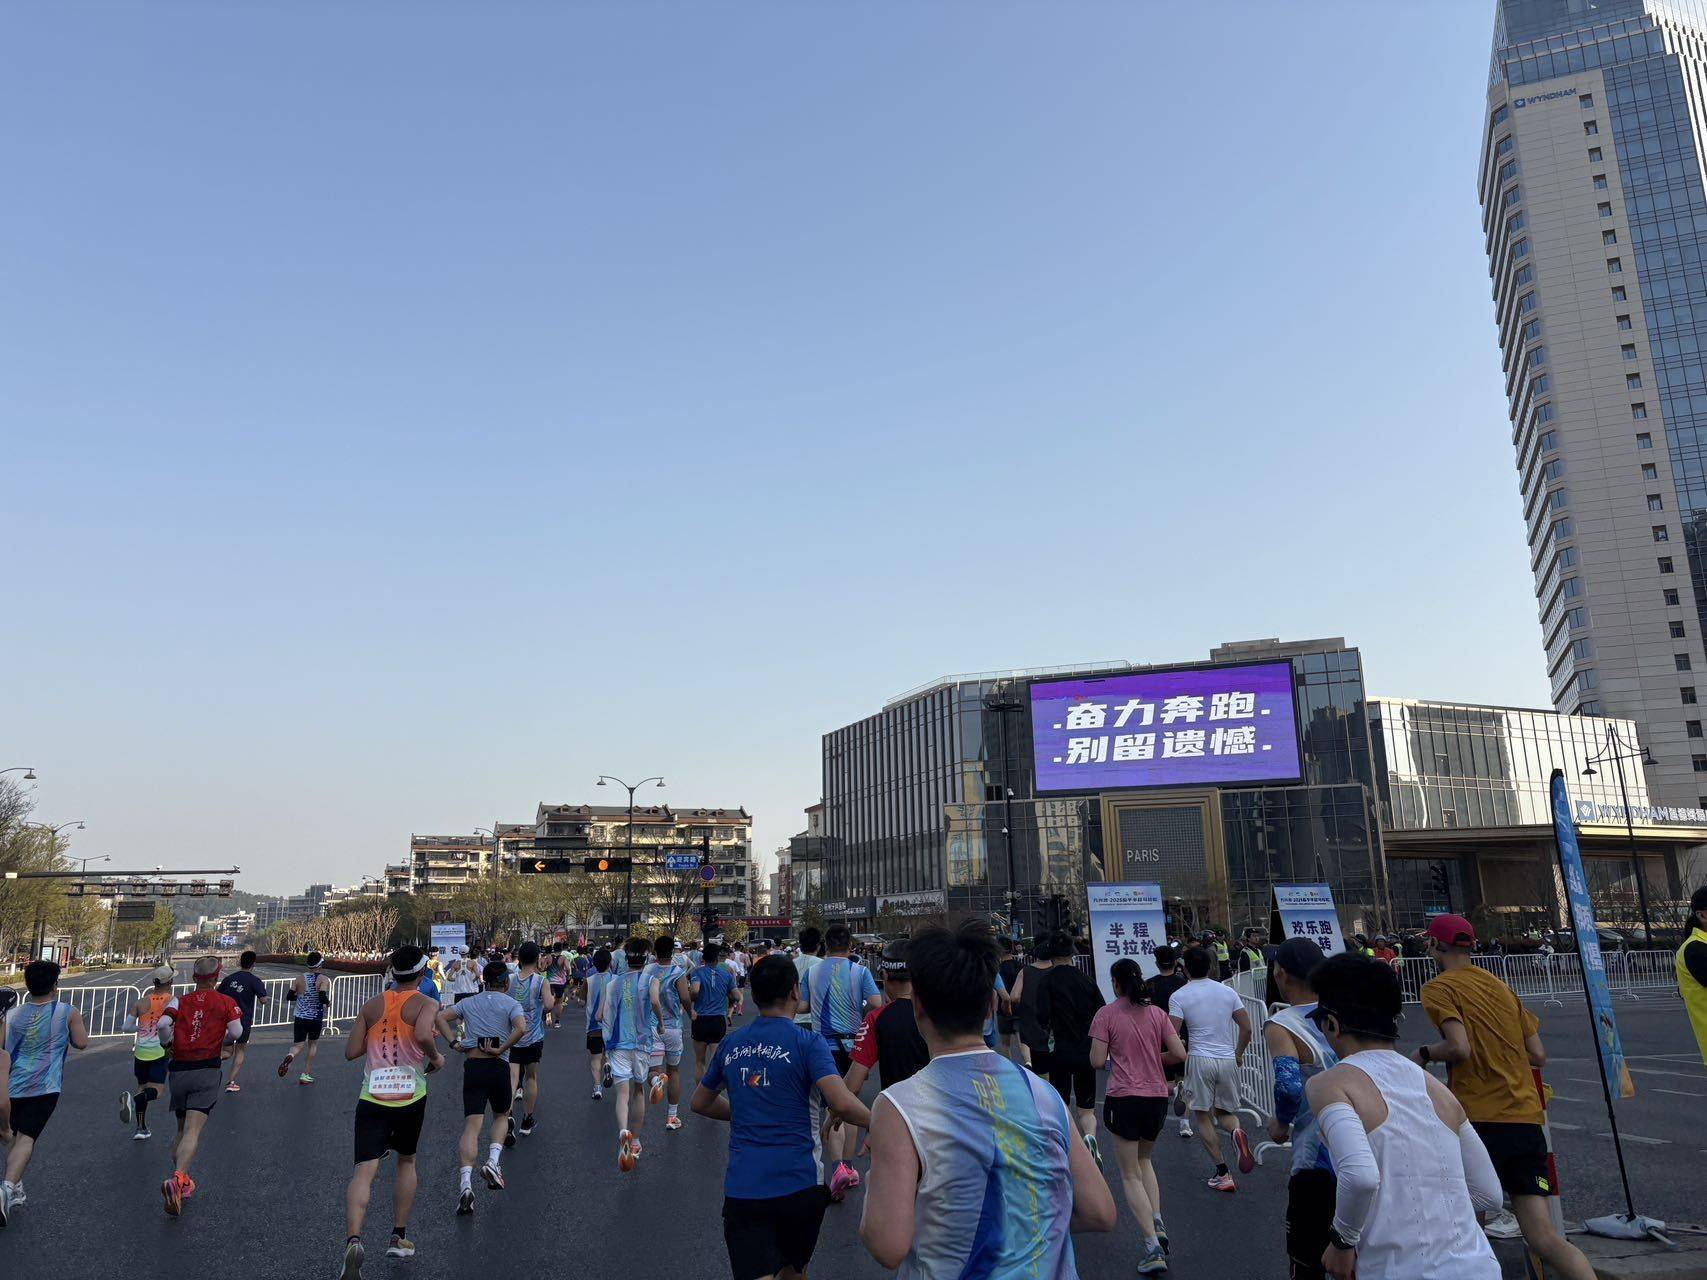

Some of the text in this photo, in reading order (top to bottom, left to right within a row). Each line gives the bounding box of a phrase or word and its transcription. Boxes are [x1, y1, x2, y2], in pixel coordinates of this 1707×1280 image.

[1066, 691, 1256, 730] 奋力奔跑
[1066, 725, 1257, 765] 别留遗憾
[1127, 848, 1159, 862] PARIS
[1109, 922, 1150, 938] 半程
[1291, 920, 1333, 935] 欢乐跑
[1105, 940, 1157, 956] 马拉松
